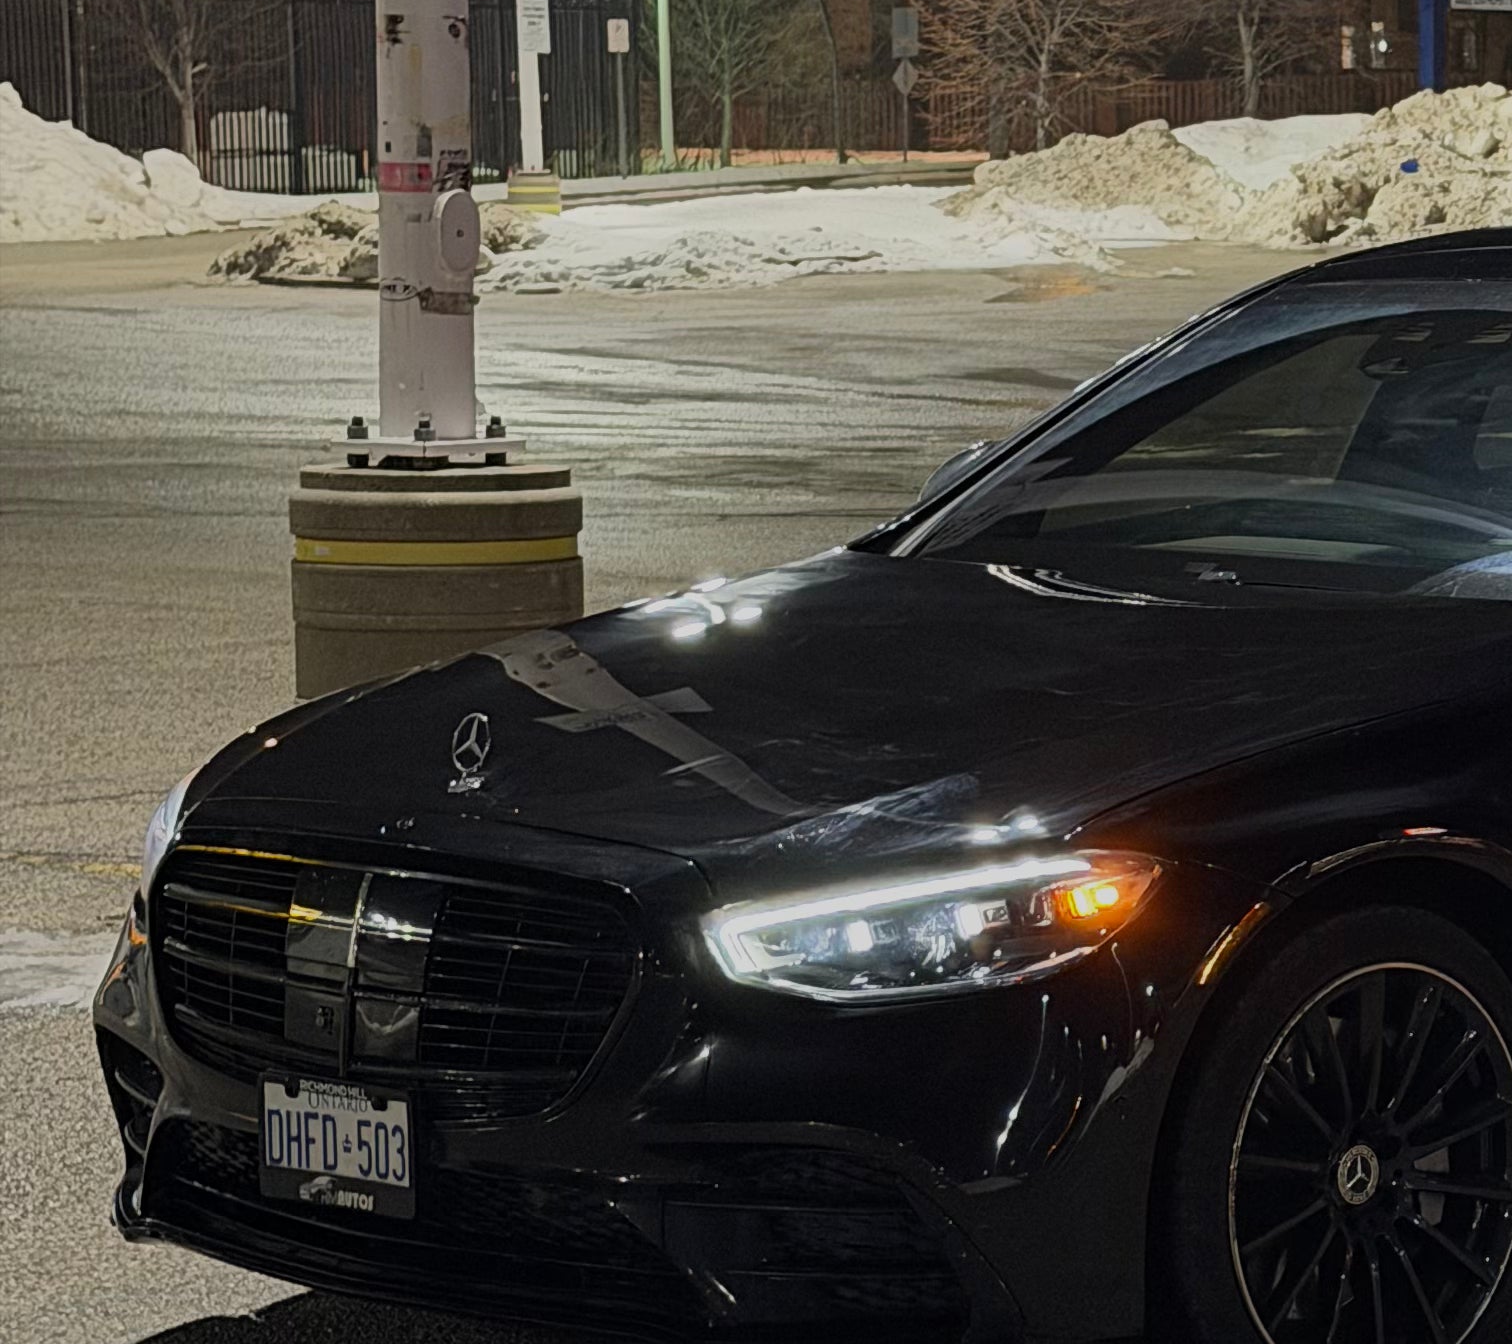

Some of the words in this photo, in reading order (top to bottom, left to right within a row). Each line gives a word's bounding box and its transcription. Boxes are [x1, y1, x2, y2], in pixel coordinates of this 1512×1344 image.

[299, 1079, 347, 1096] RICHMOND
[347, 1085, 369, 1100] HILL
[267, 1109, 339, 1171] DHFD
[357, 1119, 406, 1182] 503
